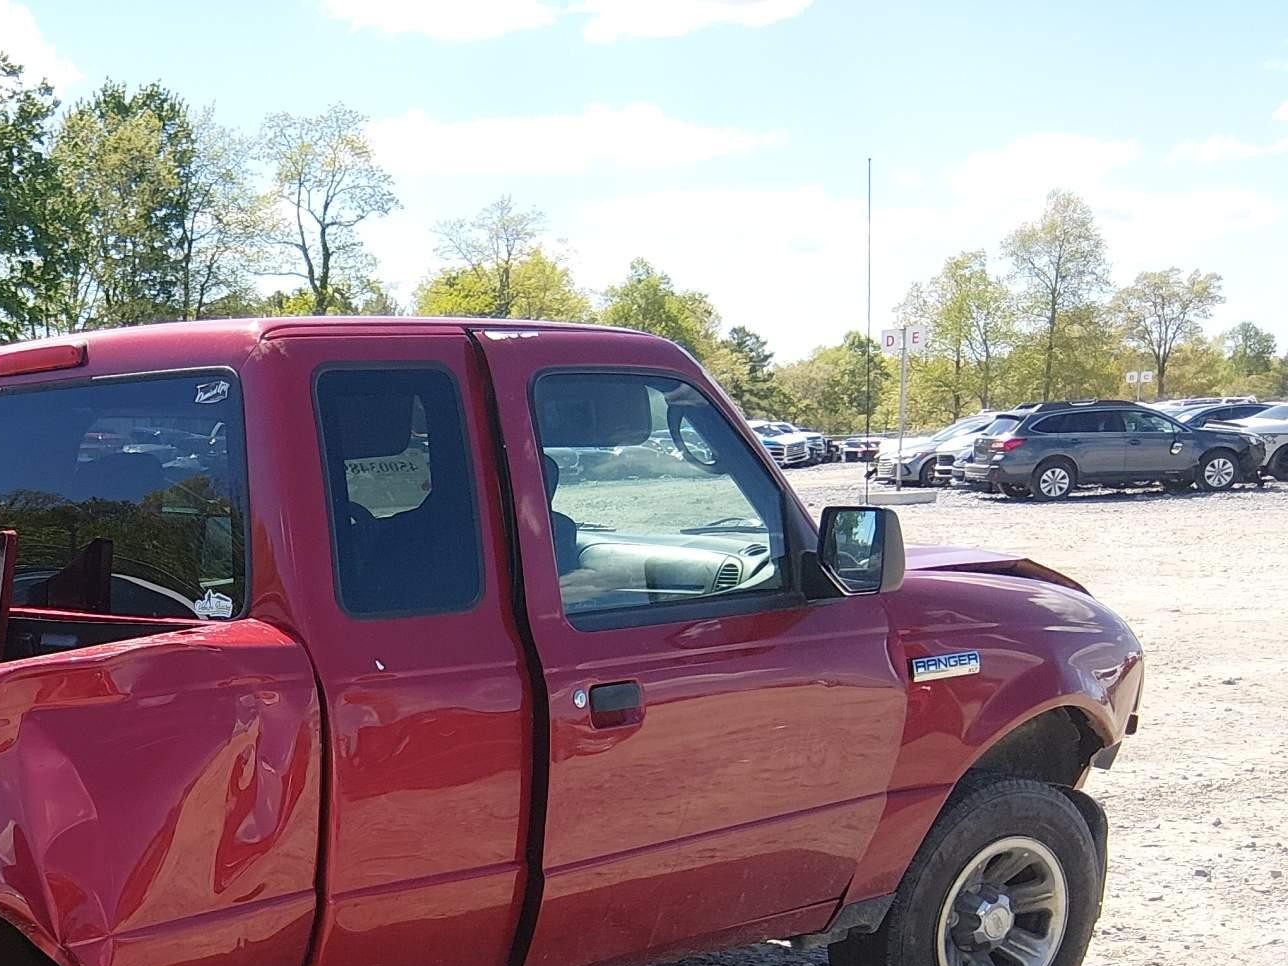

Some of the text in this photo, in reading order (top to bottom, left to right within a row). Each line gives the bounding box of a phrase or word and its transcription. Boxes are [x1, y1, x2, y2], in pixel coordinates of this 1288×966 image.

[886, 335, 895, 347] D
[912, 332, 920, 344] E
[915, 653, 978, 672] RANGER
